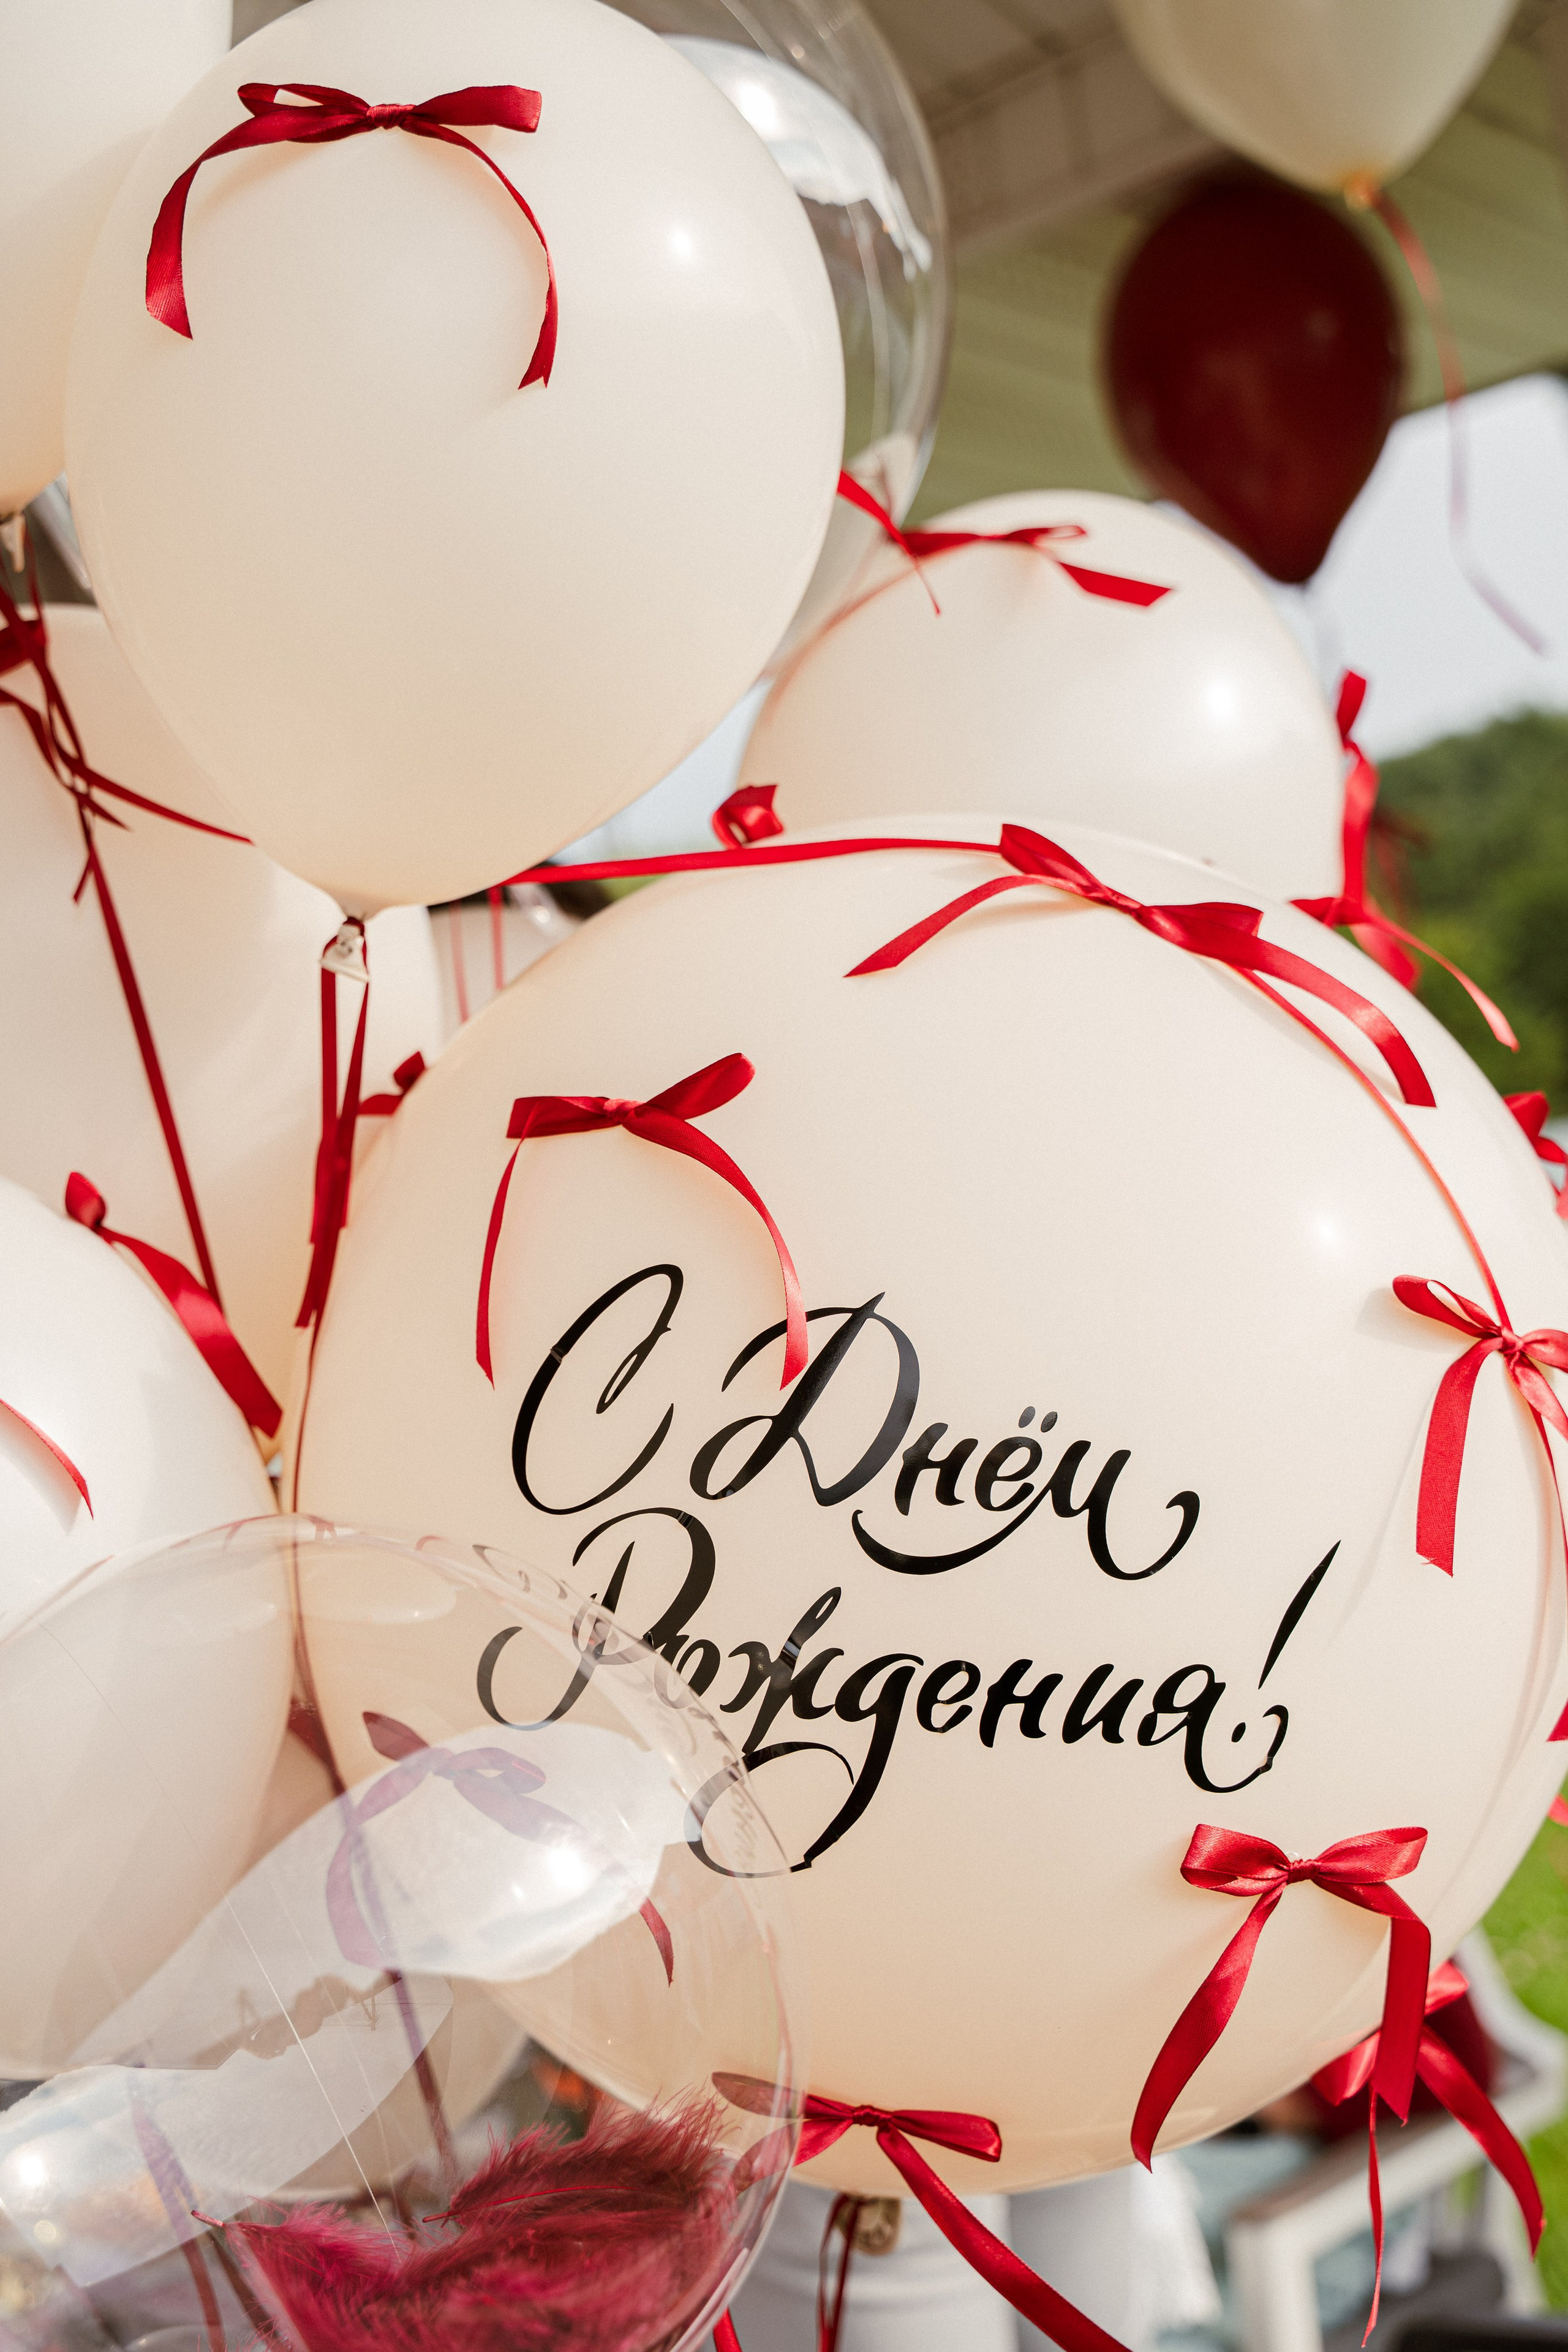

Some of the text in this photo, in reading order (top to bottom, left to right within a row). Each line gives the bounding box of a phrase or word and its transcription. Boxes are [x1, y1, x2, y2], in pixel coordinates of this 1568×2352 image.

[512, 1264, 1200, 1580] С Днём
[477, 1507, 1341, 1879] Рождения!
